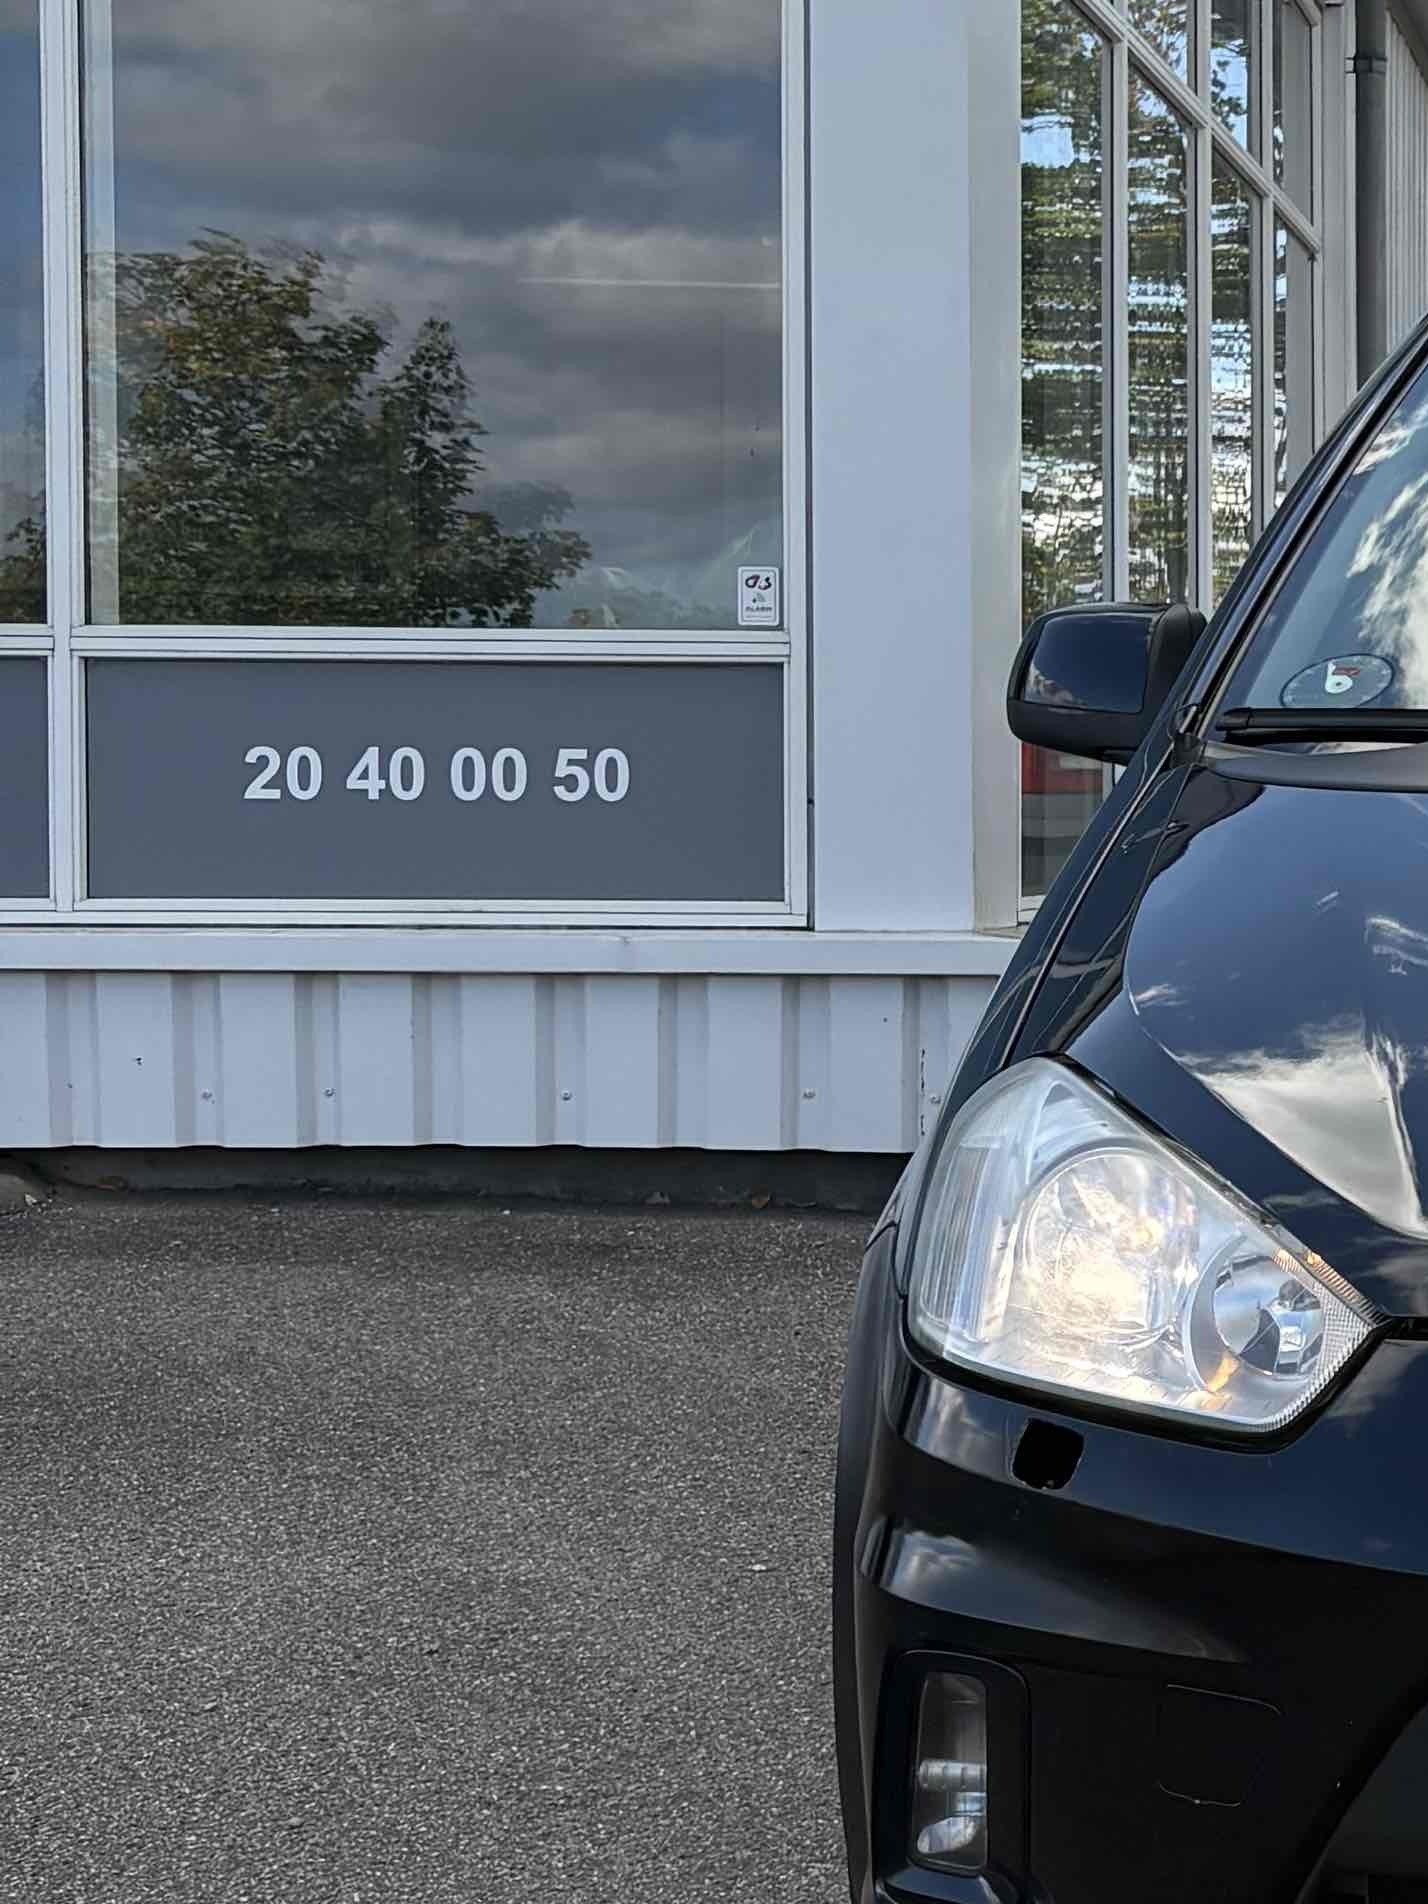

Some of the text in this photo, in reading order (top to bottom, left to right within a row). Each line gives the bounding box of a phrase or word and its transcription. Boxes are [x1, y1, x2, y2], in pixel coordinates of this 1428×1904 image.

[243, 745, 630, 802] 20 40 00 50
